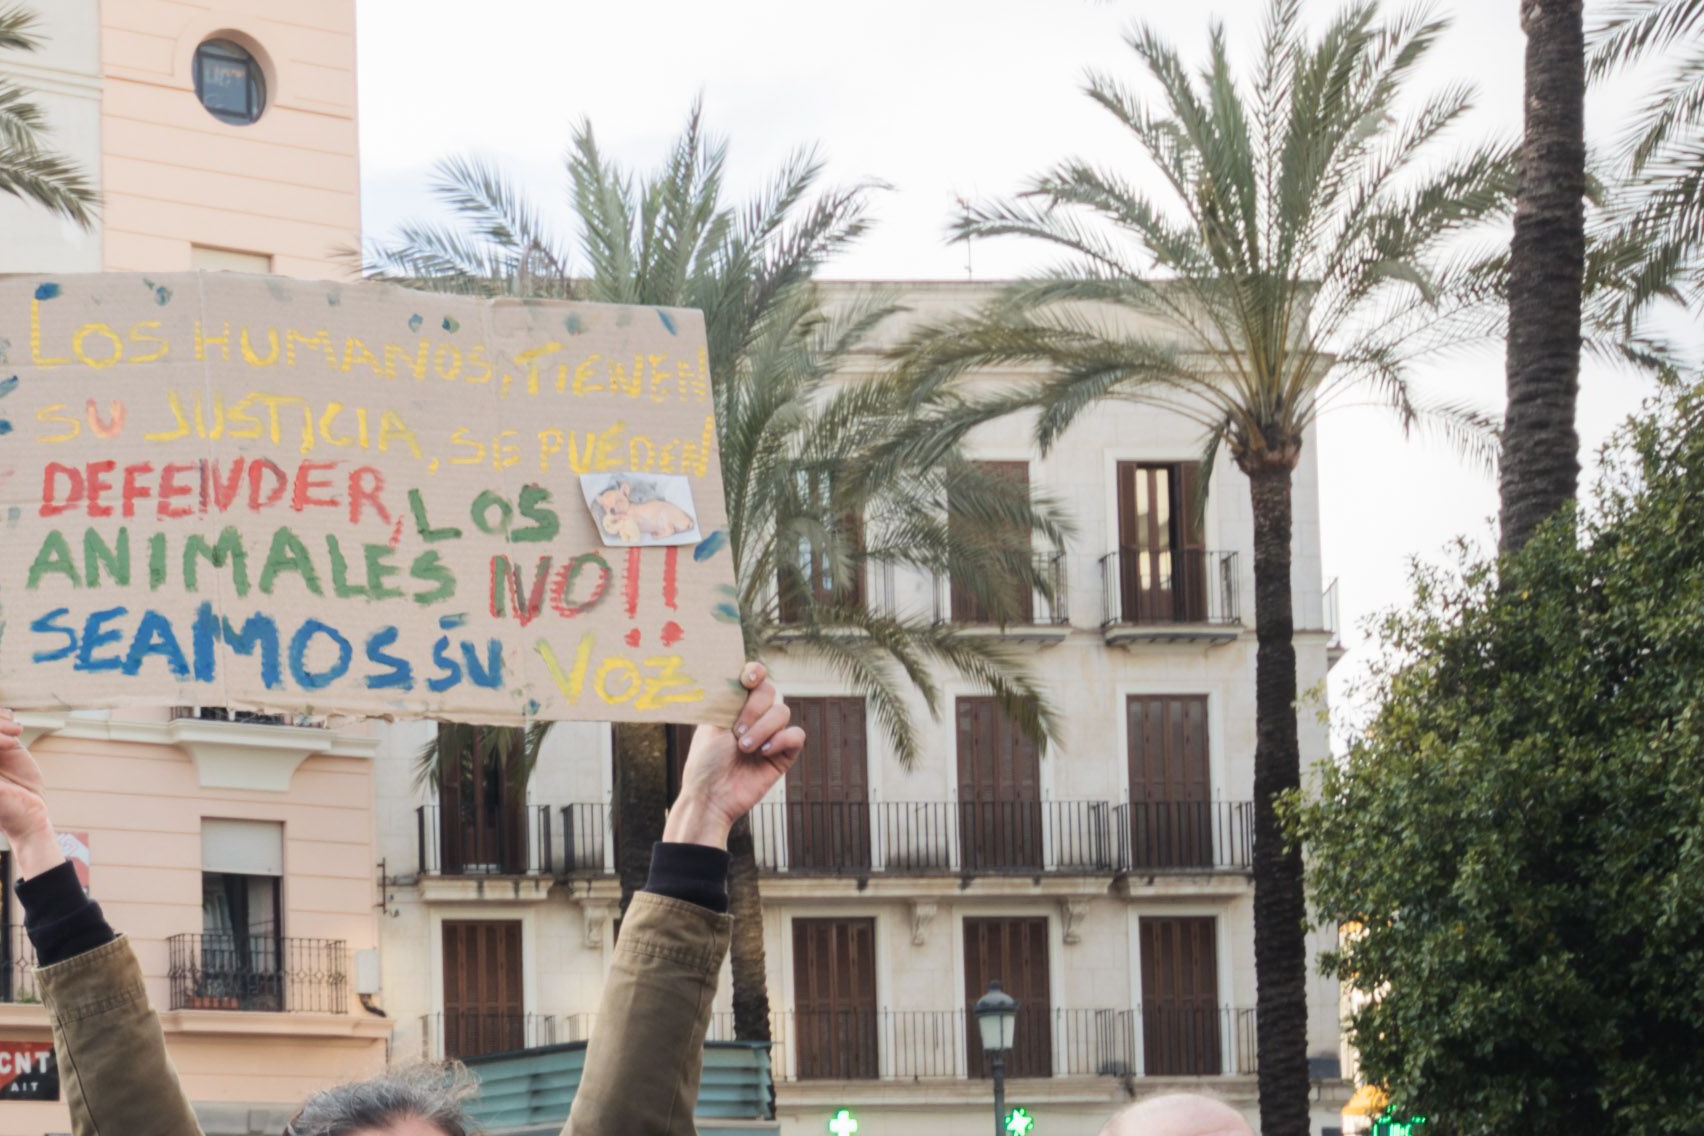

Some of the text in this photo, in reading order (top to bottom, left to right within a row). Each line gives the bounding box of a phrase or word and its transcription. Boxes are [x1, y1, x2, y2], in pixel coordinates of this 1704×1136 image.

[31, 298, 171, 369] LOS
[514, 341, 708, 402] TIENEN
[36, 399, 125, 443] SU
[449, 427, 521, 473] SE
[537, 415, 715, 478] PUEDEN
[408, 484, 560, 542] LOS
[26, 527, 457, 602] ANIMALES
[30, 602, 704, 711] SEAMOS SU VOZ
[10, 1082, 39, 1092] AIT
